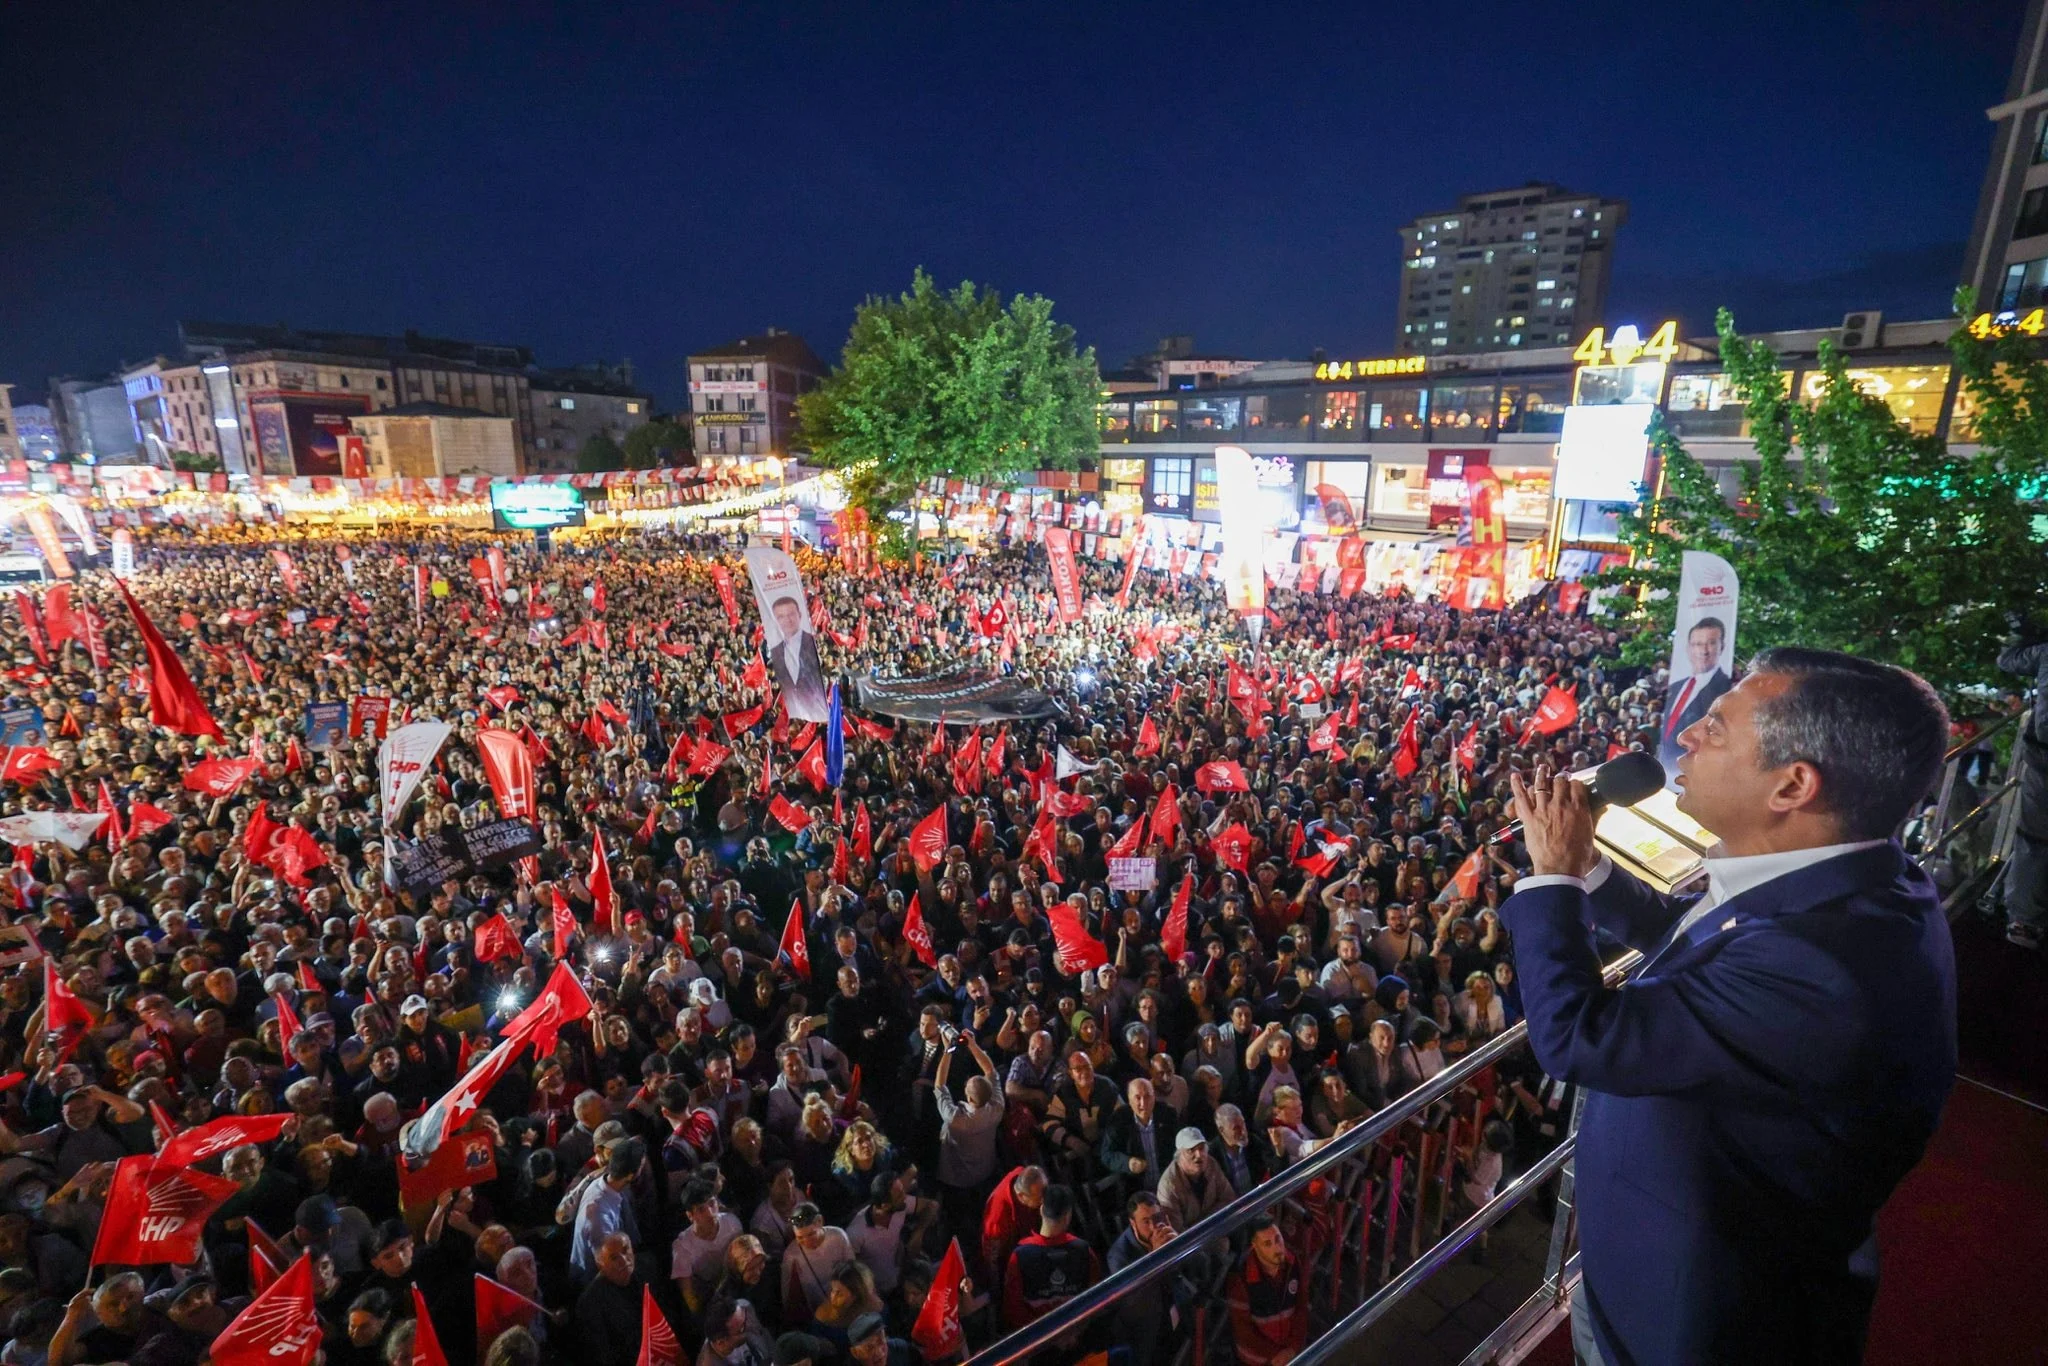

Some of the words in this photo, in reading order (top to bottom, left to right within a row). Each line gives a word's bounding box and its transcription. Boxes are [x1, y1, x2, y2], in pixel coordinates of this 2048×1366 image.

[1357, 356, 1426, 376] TERRACE
[389, 760, 421, 773] CHP
[138, 1216, 186, 1242] CHP
